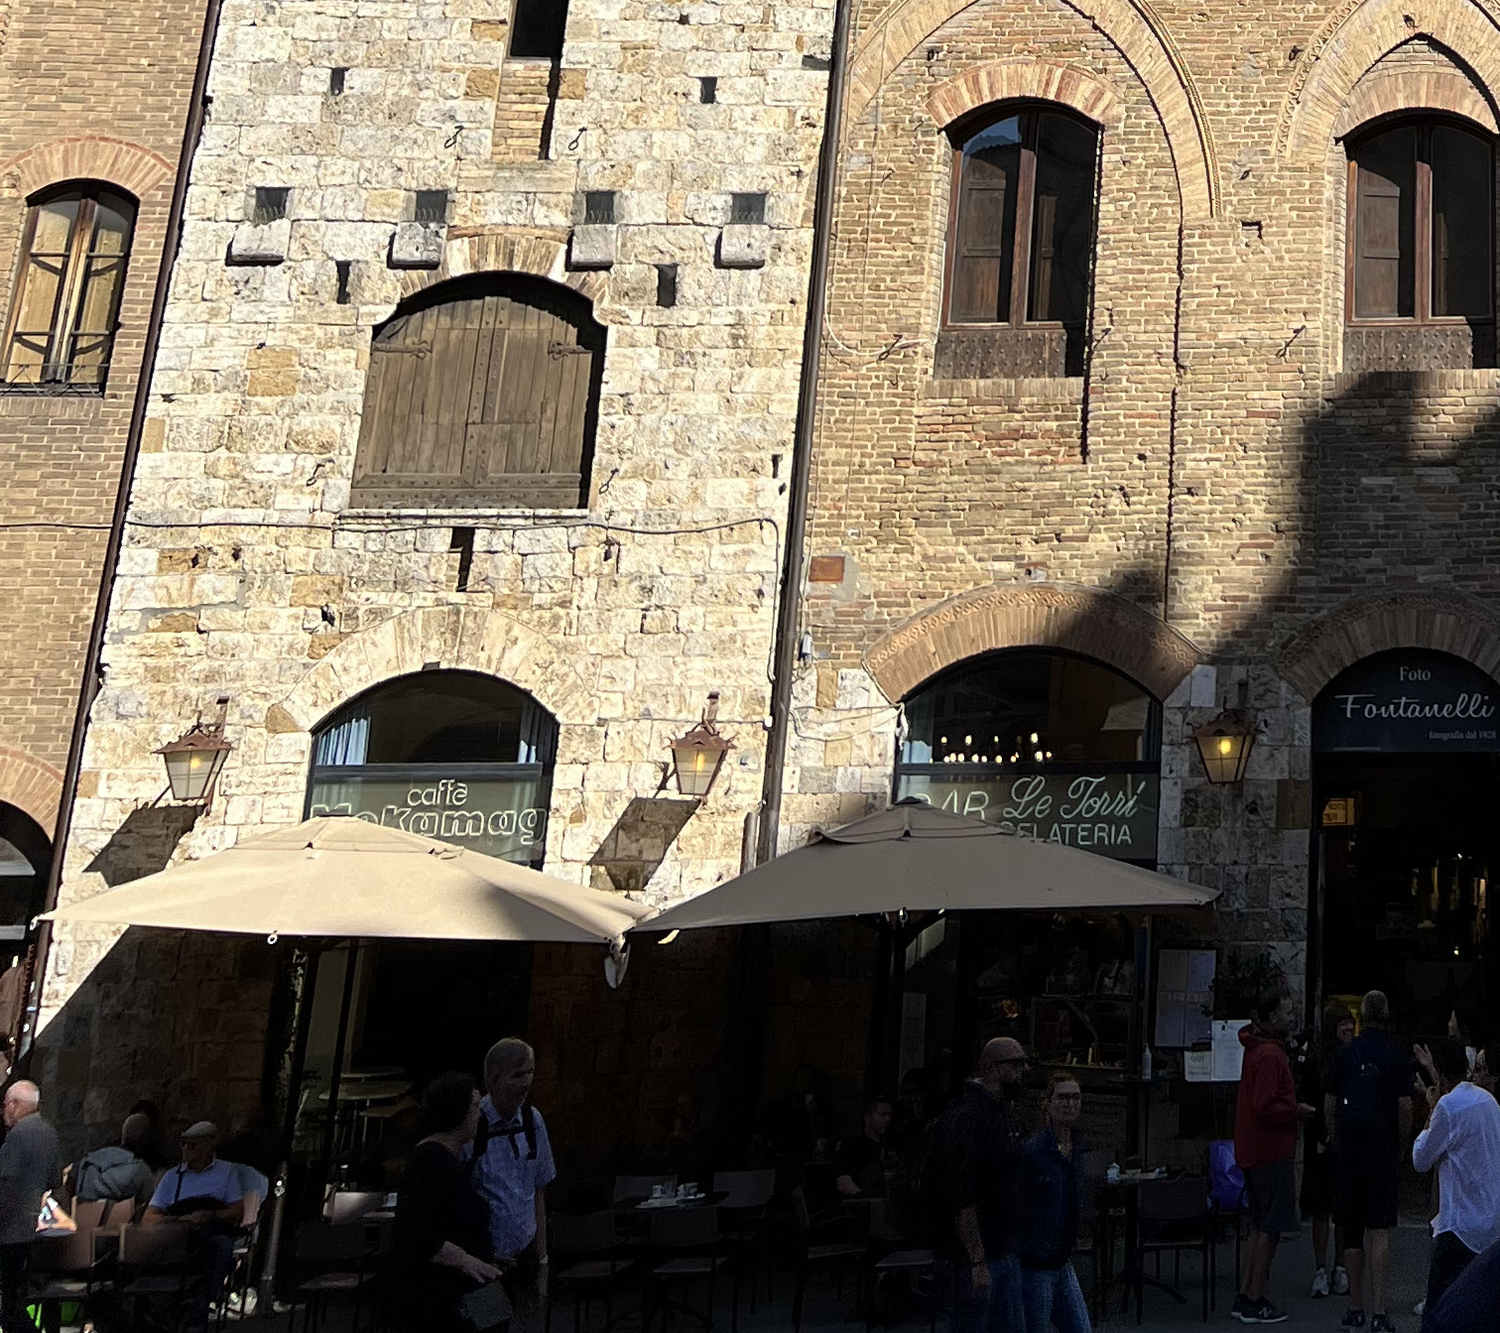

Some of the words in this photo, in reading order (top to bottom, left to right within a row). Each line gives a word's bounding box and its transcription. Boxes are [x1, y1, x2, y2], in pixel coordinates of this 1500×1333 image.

[1399, 665, 1431, 681] Foto
[1334, 692, 1497, 719] Fontanelli
[1002, 775, 1053, 818] Le
[1060, 775, 1146, 819] Torri
